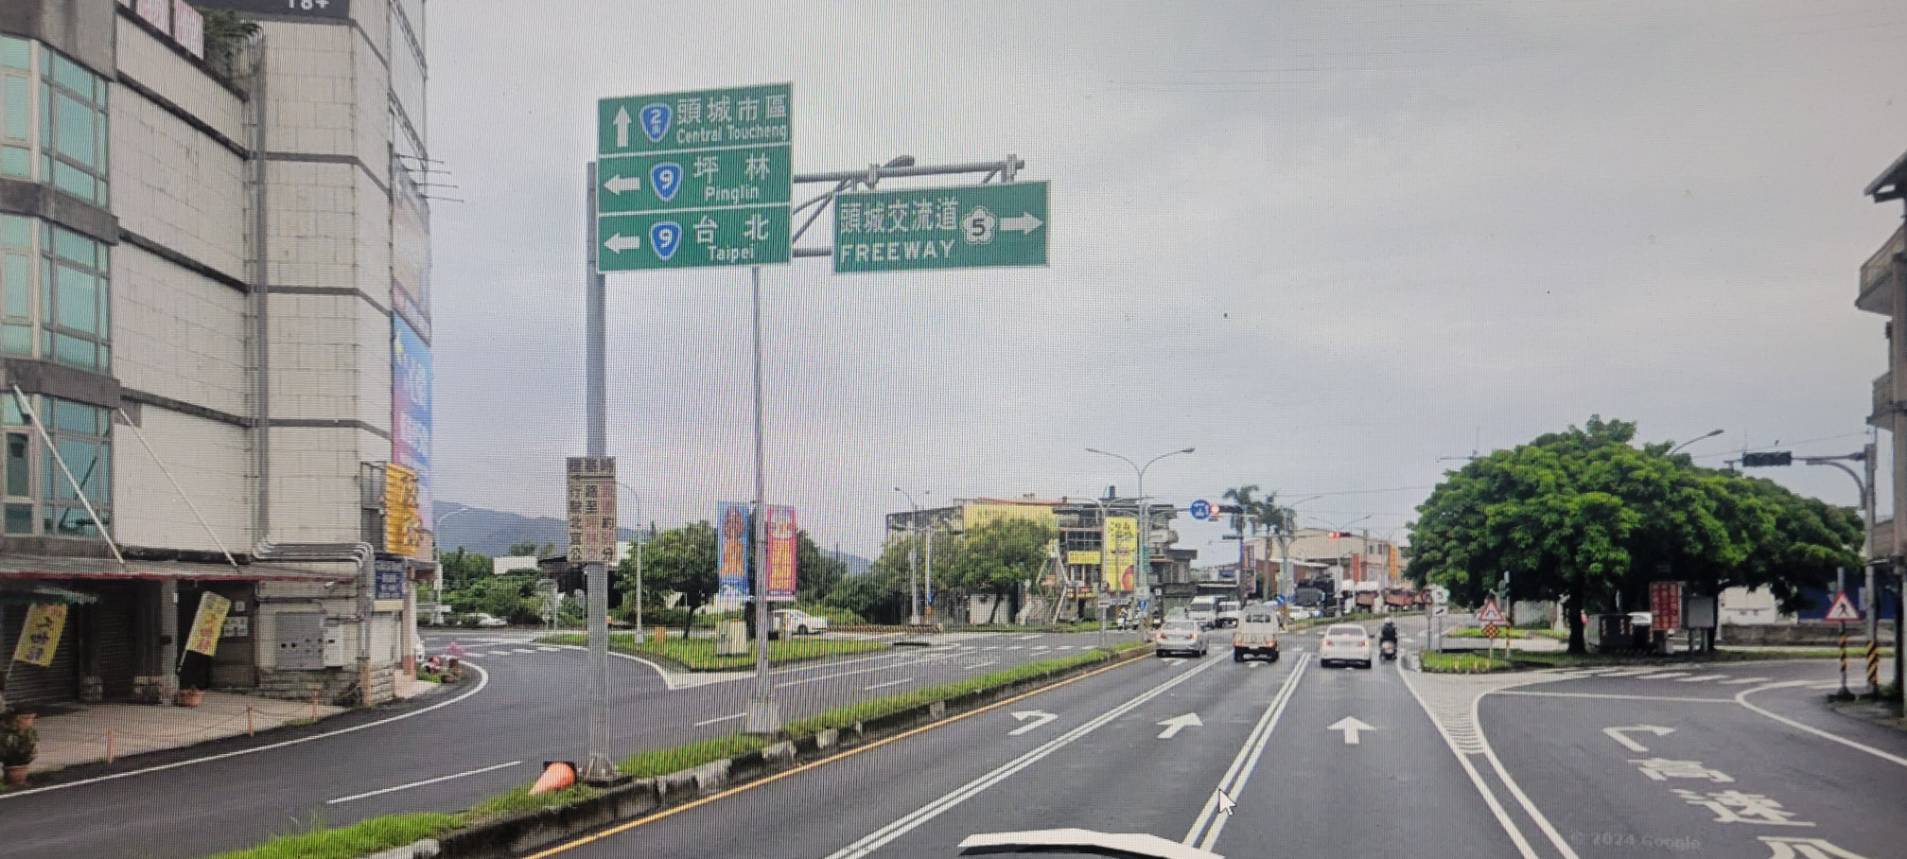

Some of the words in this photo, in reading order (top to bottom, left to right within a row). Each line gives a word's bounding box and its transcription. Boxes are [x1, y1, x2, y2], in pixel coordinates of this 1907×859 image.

[677, 94, 787, 124] 頭城市區
[676, 127, 722, 144] Central
[727, 124, 787, 142] Toucheng
[659, 169, 674, 189] 9
[704, 185, 760, 205] Pinglin
[840, 197, 960, 233] 頭城交流道
[971, 218, 986, 237] 5
[658, 228, 673, 248] 9
[708, 244, 755, 263] Taipei
[840, 239, 956, 263] FREEWAY
